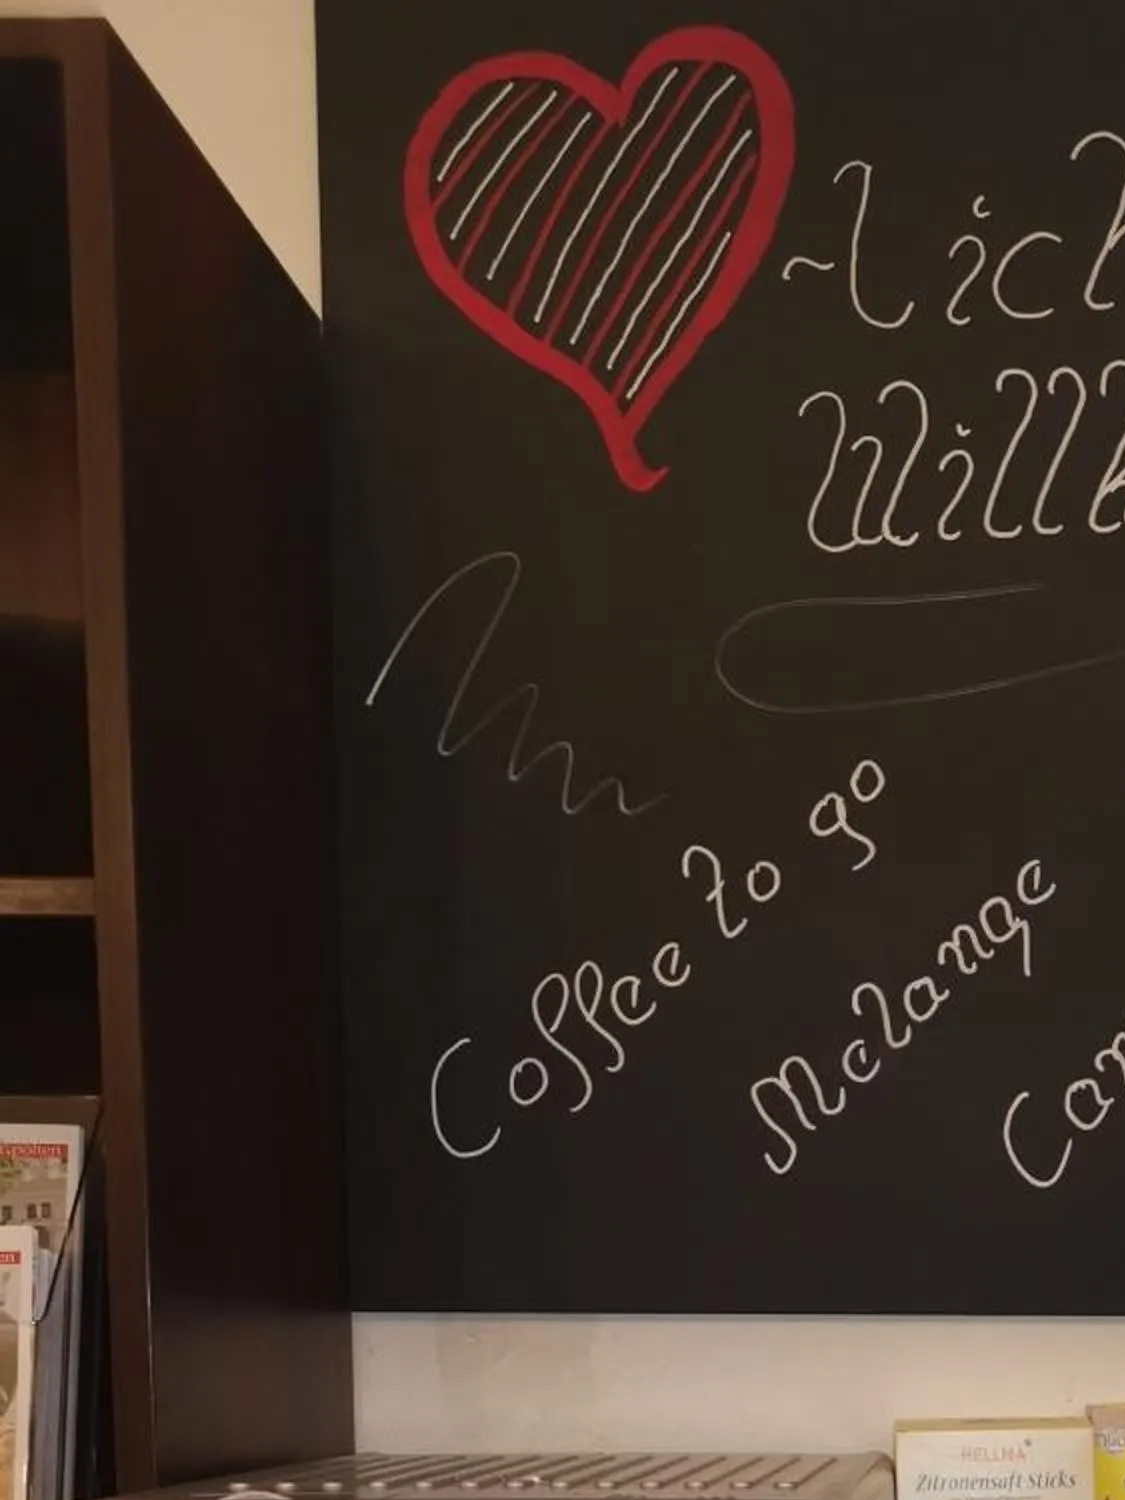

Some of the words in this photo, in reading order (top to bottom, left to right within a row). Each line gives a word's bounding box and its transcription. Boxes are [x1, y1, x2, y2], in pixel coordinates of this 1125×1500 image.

[432, 941, 691, 1158] Coffee
[682, 845, 781, 938] to
[809, 759, 885, 871] go
[750, 858, 1057, 1175] Melange
[915, 1472, 1024, 1493] Zitronensaft
[1027, 1470, 1077, 1488] Sticks
